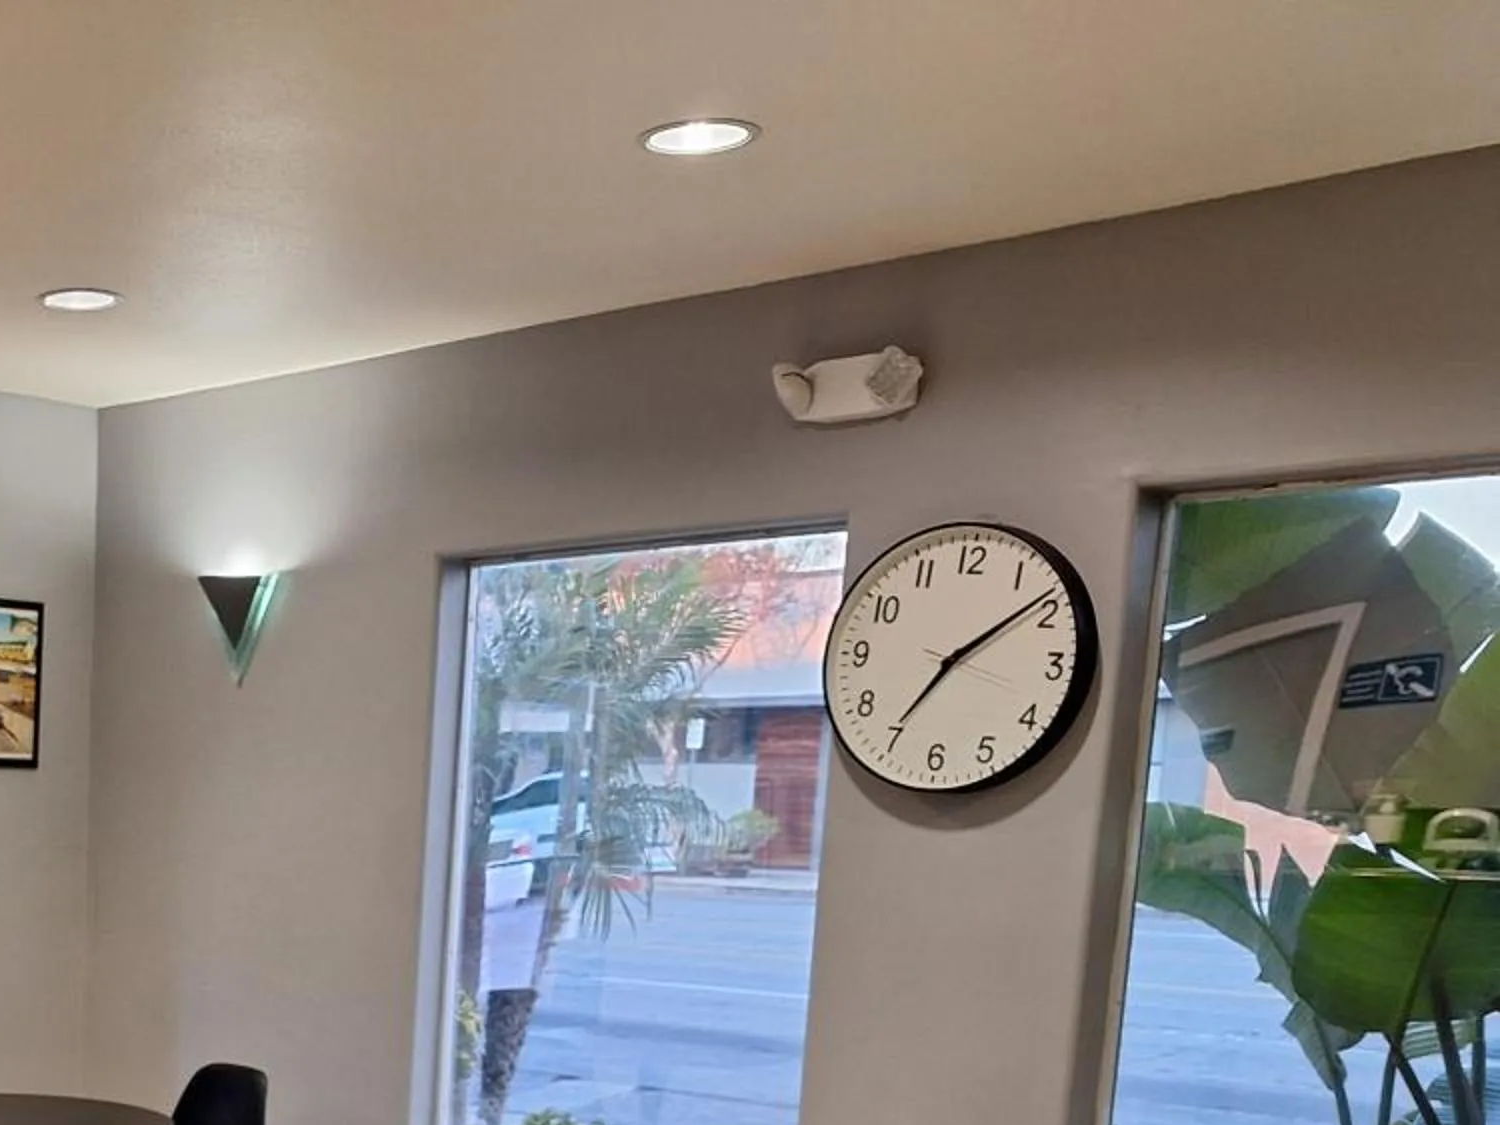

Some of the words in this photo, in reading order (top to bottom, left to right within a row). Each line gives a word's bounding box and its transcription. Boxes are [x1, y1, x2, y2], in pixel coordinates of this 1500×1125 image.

[915, 559, 935, 588] 11
[958, 546, 987, 575] 12
[1014, 561, 1024, 590] 1
[873, 595, 900, 624] 10
[1037, 599, 1059, 629] 2
[852, 640, 870, 667] 9
[1044, 652, 1065, 681] 3
[857, 690, 875, 717] 8
[1018, 703, 1038, 730] 4
[887, 726, 904, 753] 7
[976, 736, 997, 764] 5
[927, 743, 946, 771] 6
